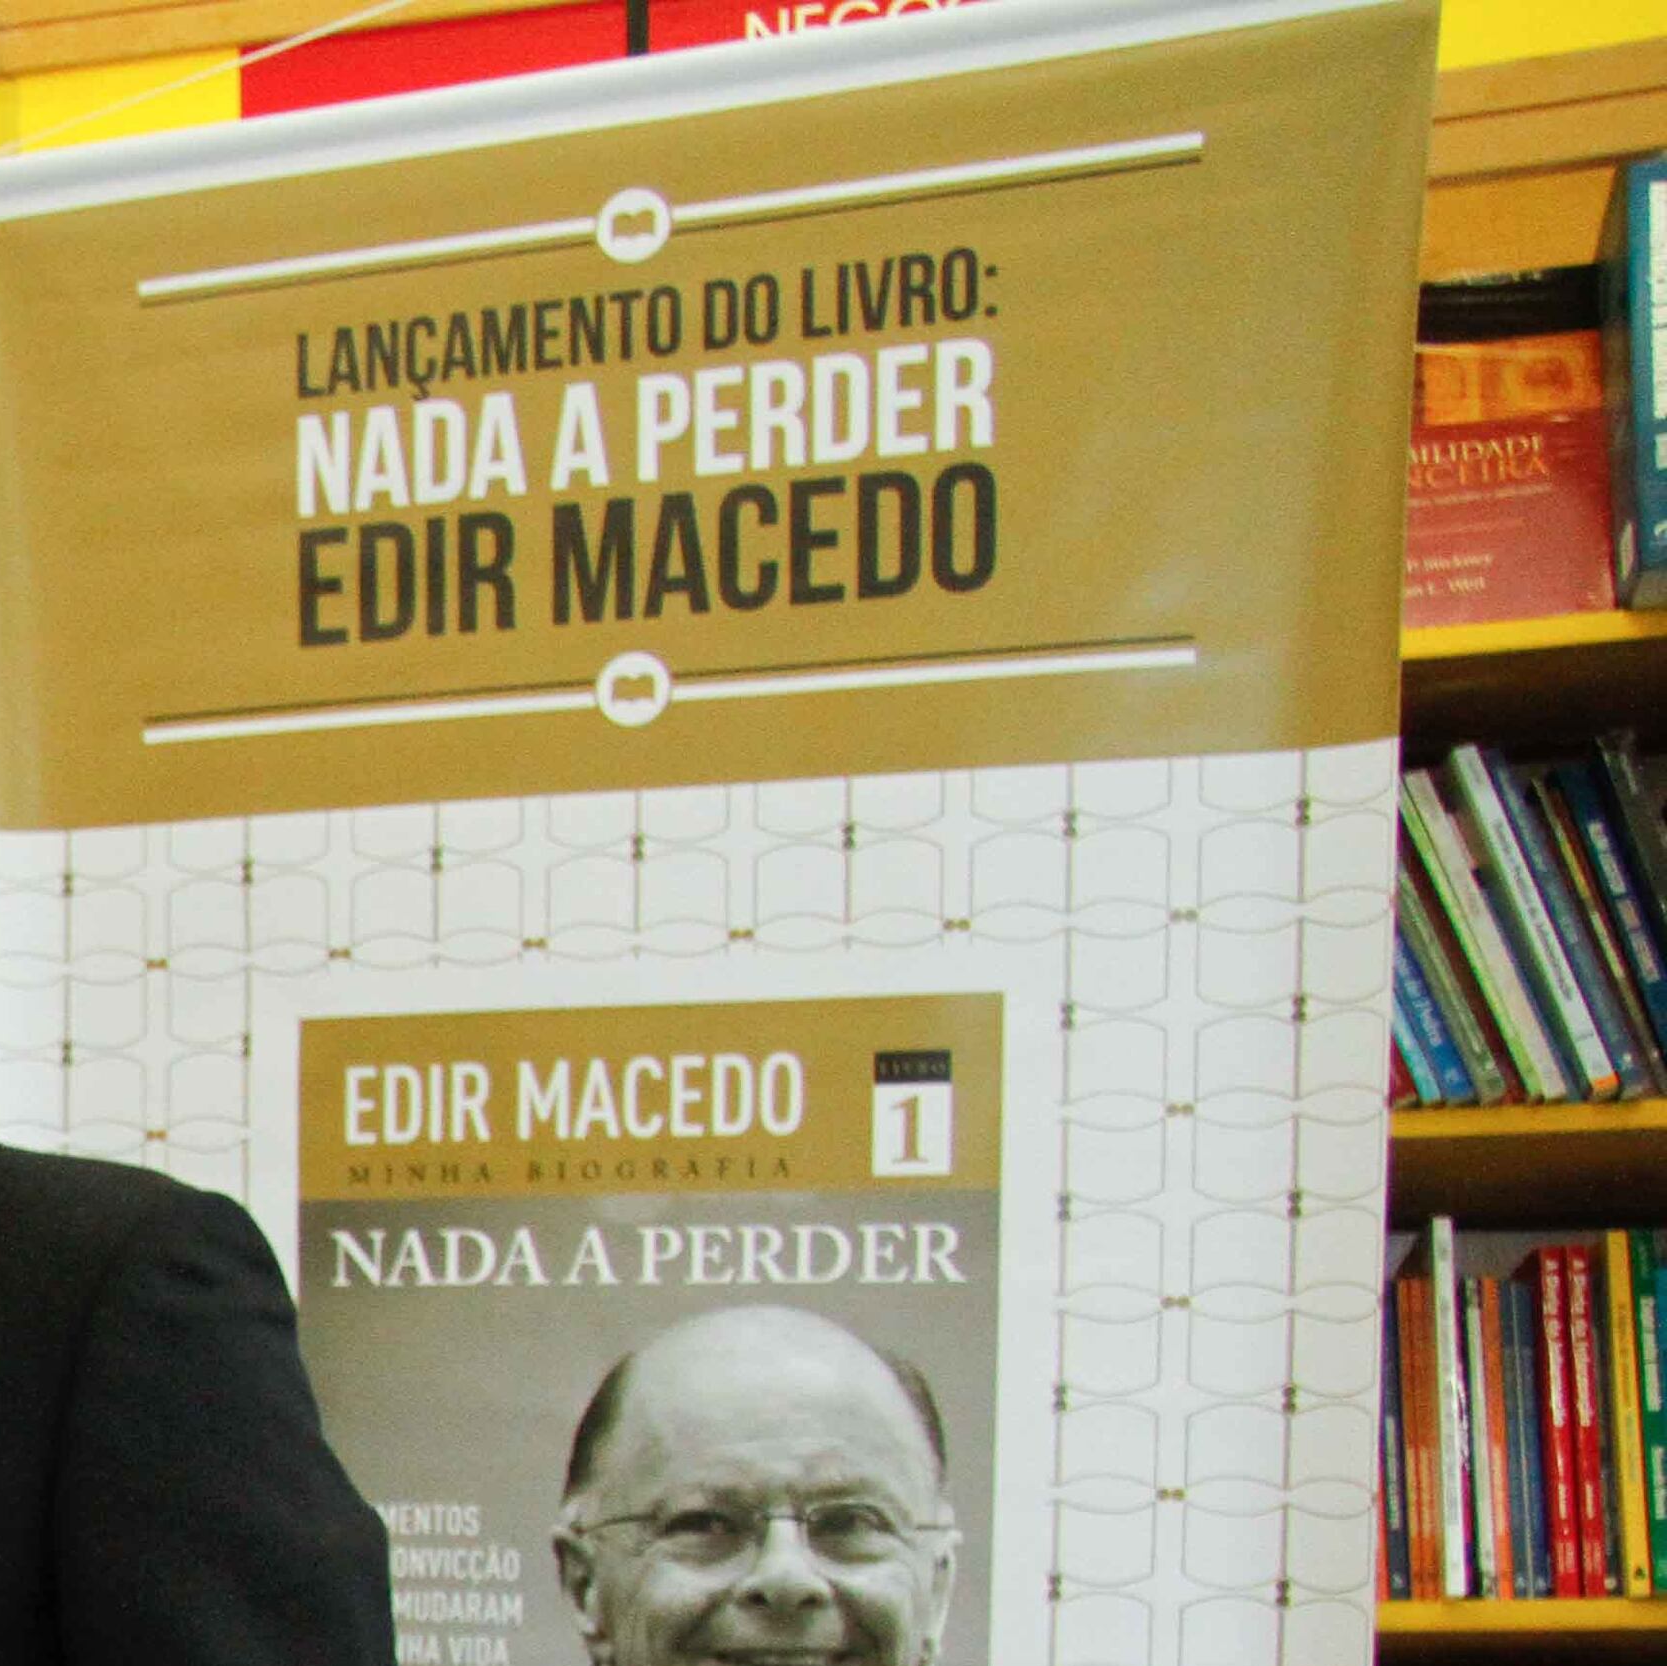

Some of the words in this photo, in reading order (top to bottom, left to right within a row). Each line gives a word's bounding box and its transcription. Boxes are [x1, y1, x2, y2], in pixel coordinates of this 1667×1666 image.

[296, 284, 683, 402] LANÇAMENTO
[702, 271, 781, 352] DO
[801, 246, 998, 338] LIVRO:
[296, 391, 528, 520] NADA
[551, 381, 611, 491] A
[637, 336, 994, 482] PERDER
[297, 509, 516, 648] EDIR
[551, 461, 998, 627] MACEDO
[344, 1061, 491, 1147] EDIR
[517, 1051, 804, 1142] MACEDO
[889, 1095, 929, 1165] 1
[348, 1162, 494, 1187] MINHA
[527, 1156, 793, 1184] BIOGRAFIA
[330, 1225, 551, 1289] NADA
[567, 1226, 625, 1288] A
[637, 1221, 968, 1286] PERDER
[376, 1502, 482, 1537] MENTOS
[390, 1542, 522, 1585] ONVICÇÃO
